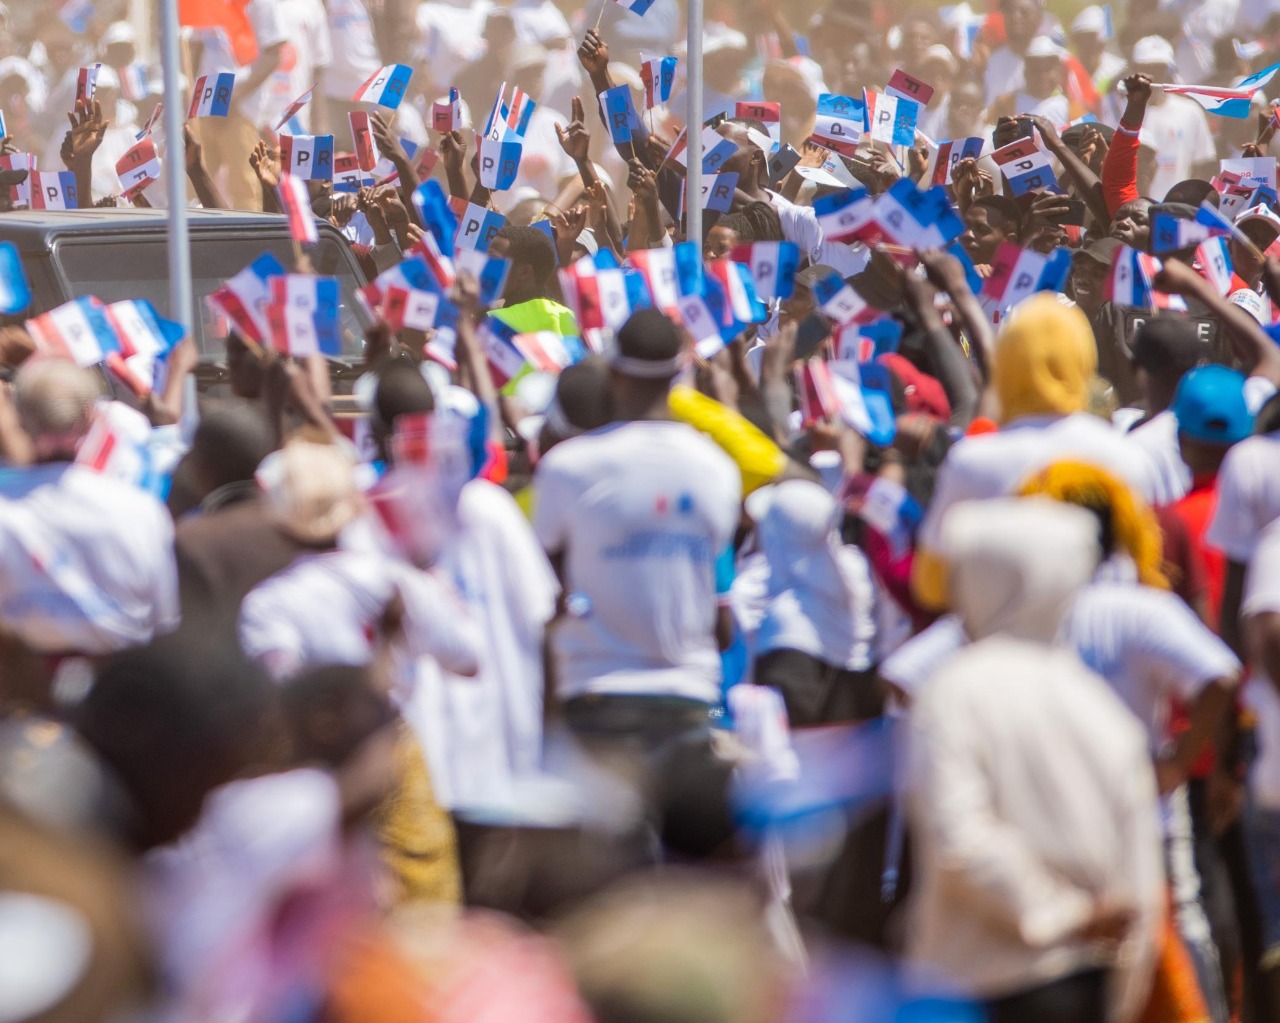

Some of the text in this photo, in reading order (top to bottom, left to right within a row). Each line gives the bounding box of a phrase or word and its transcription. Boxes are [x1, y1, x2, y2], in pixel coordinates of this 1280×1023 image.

[194, 86, 230, 105] FPR
[481, 157, 517, 176] PR
[1005, 148, 1044, 191] FPR
[32, 183, 77, 202] FPR
